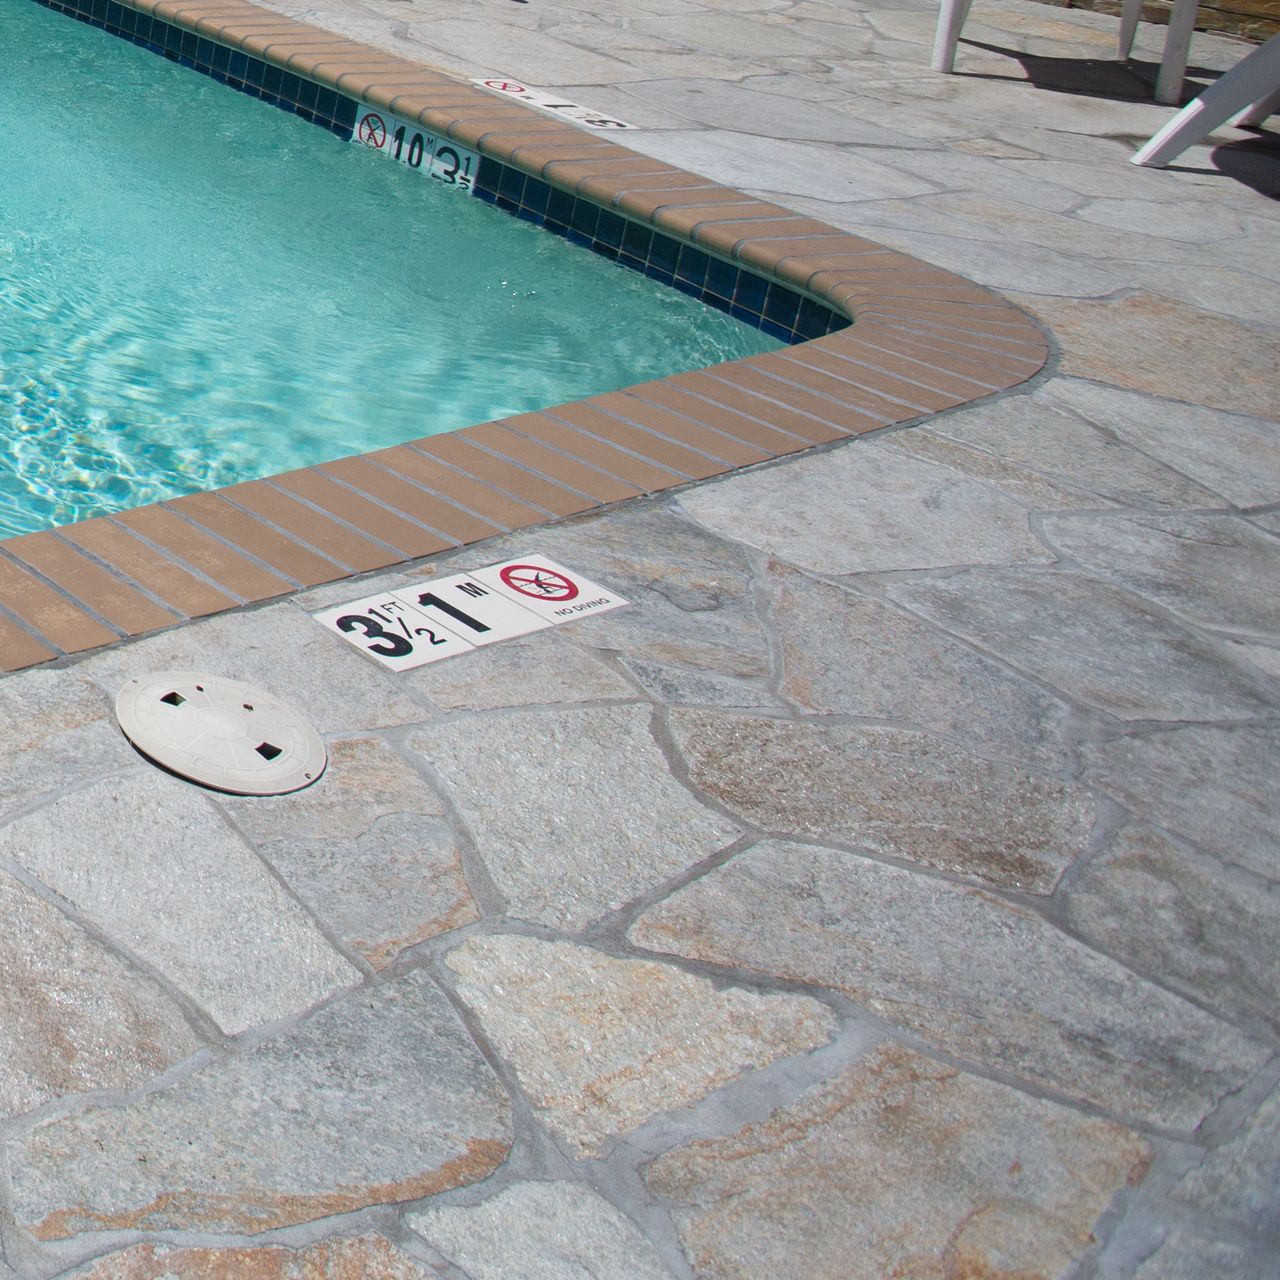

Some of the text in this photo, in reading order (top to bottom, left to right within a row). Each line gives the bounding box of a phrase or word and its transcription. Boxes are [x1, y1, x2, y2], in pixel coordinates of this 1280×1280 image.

[426, 137, 434, 148] M
[432, 146, 460, 184] 3
[380, 601, 404, 614] FT
[418, 582, 492, 633] 1 M
[554, 597, 610, 616] NO DIVING
